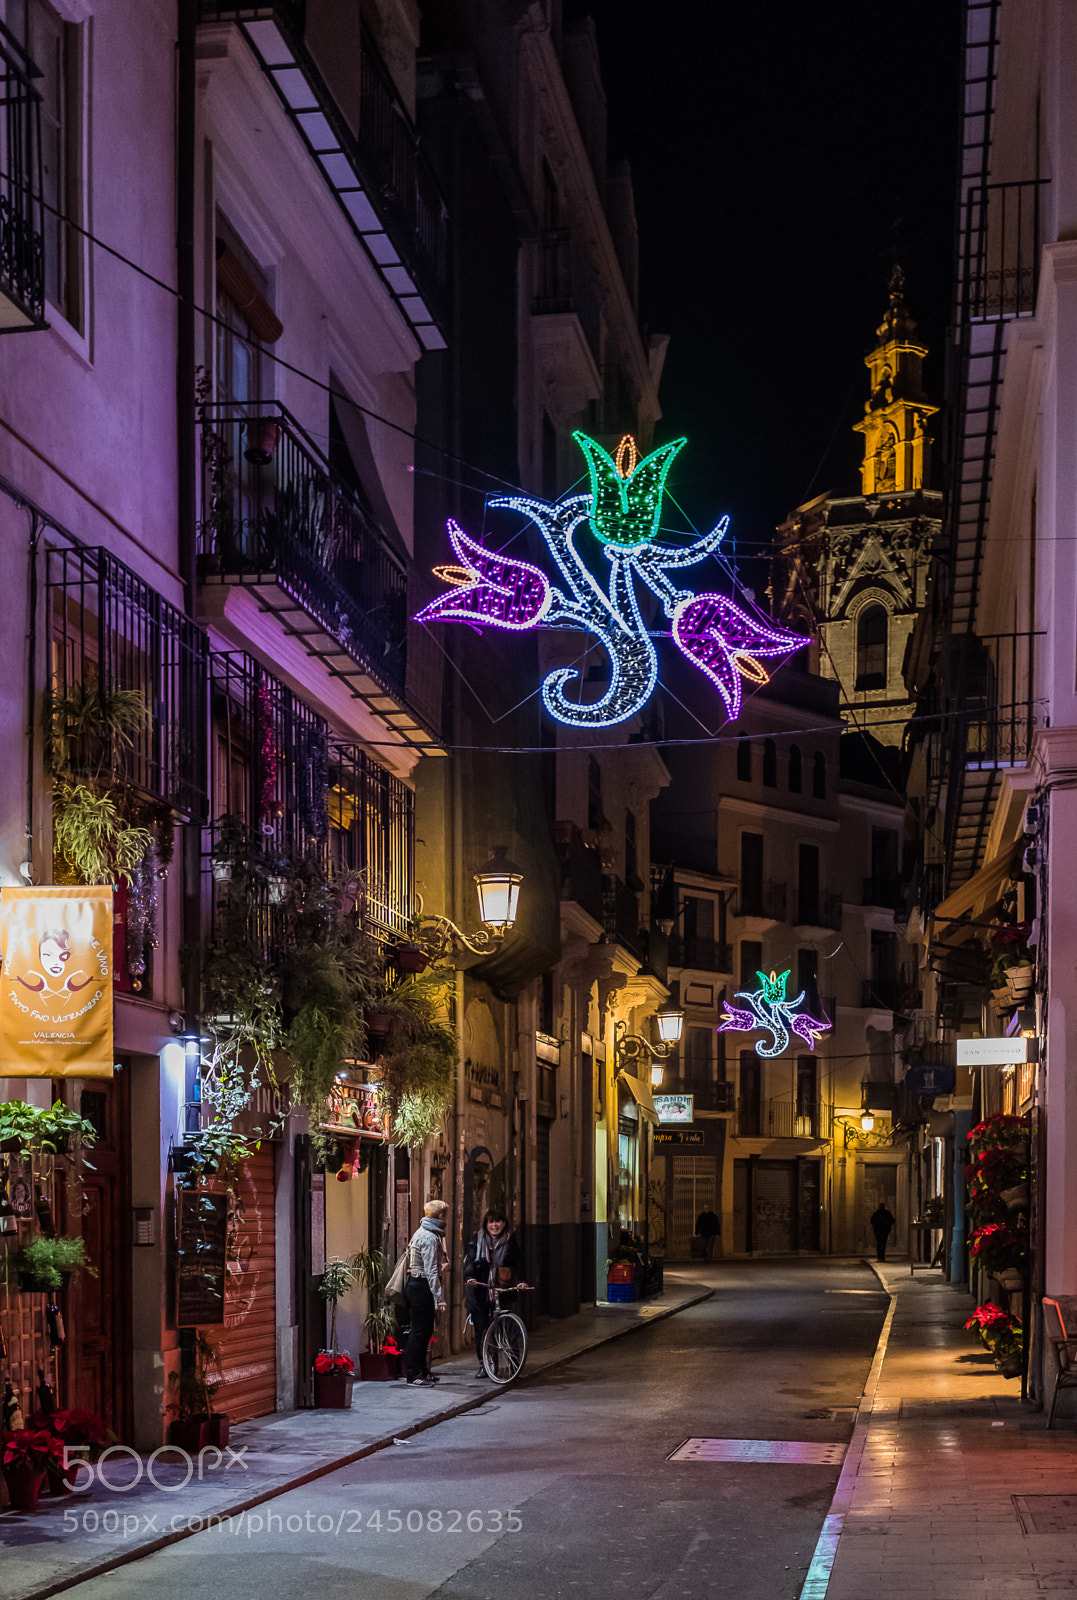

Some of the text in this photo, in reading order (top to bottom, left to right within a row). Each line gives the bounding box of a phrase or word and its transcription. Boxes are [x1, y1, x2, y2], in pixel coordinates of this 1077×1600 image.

[96, 949, 109, 976] VINO
[8, 990, 103, 1023] TINTO FINO ULTRAMARINO
[33, 1031, 76, 1039] VALENCIA
